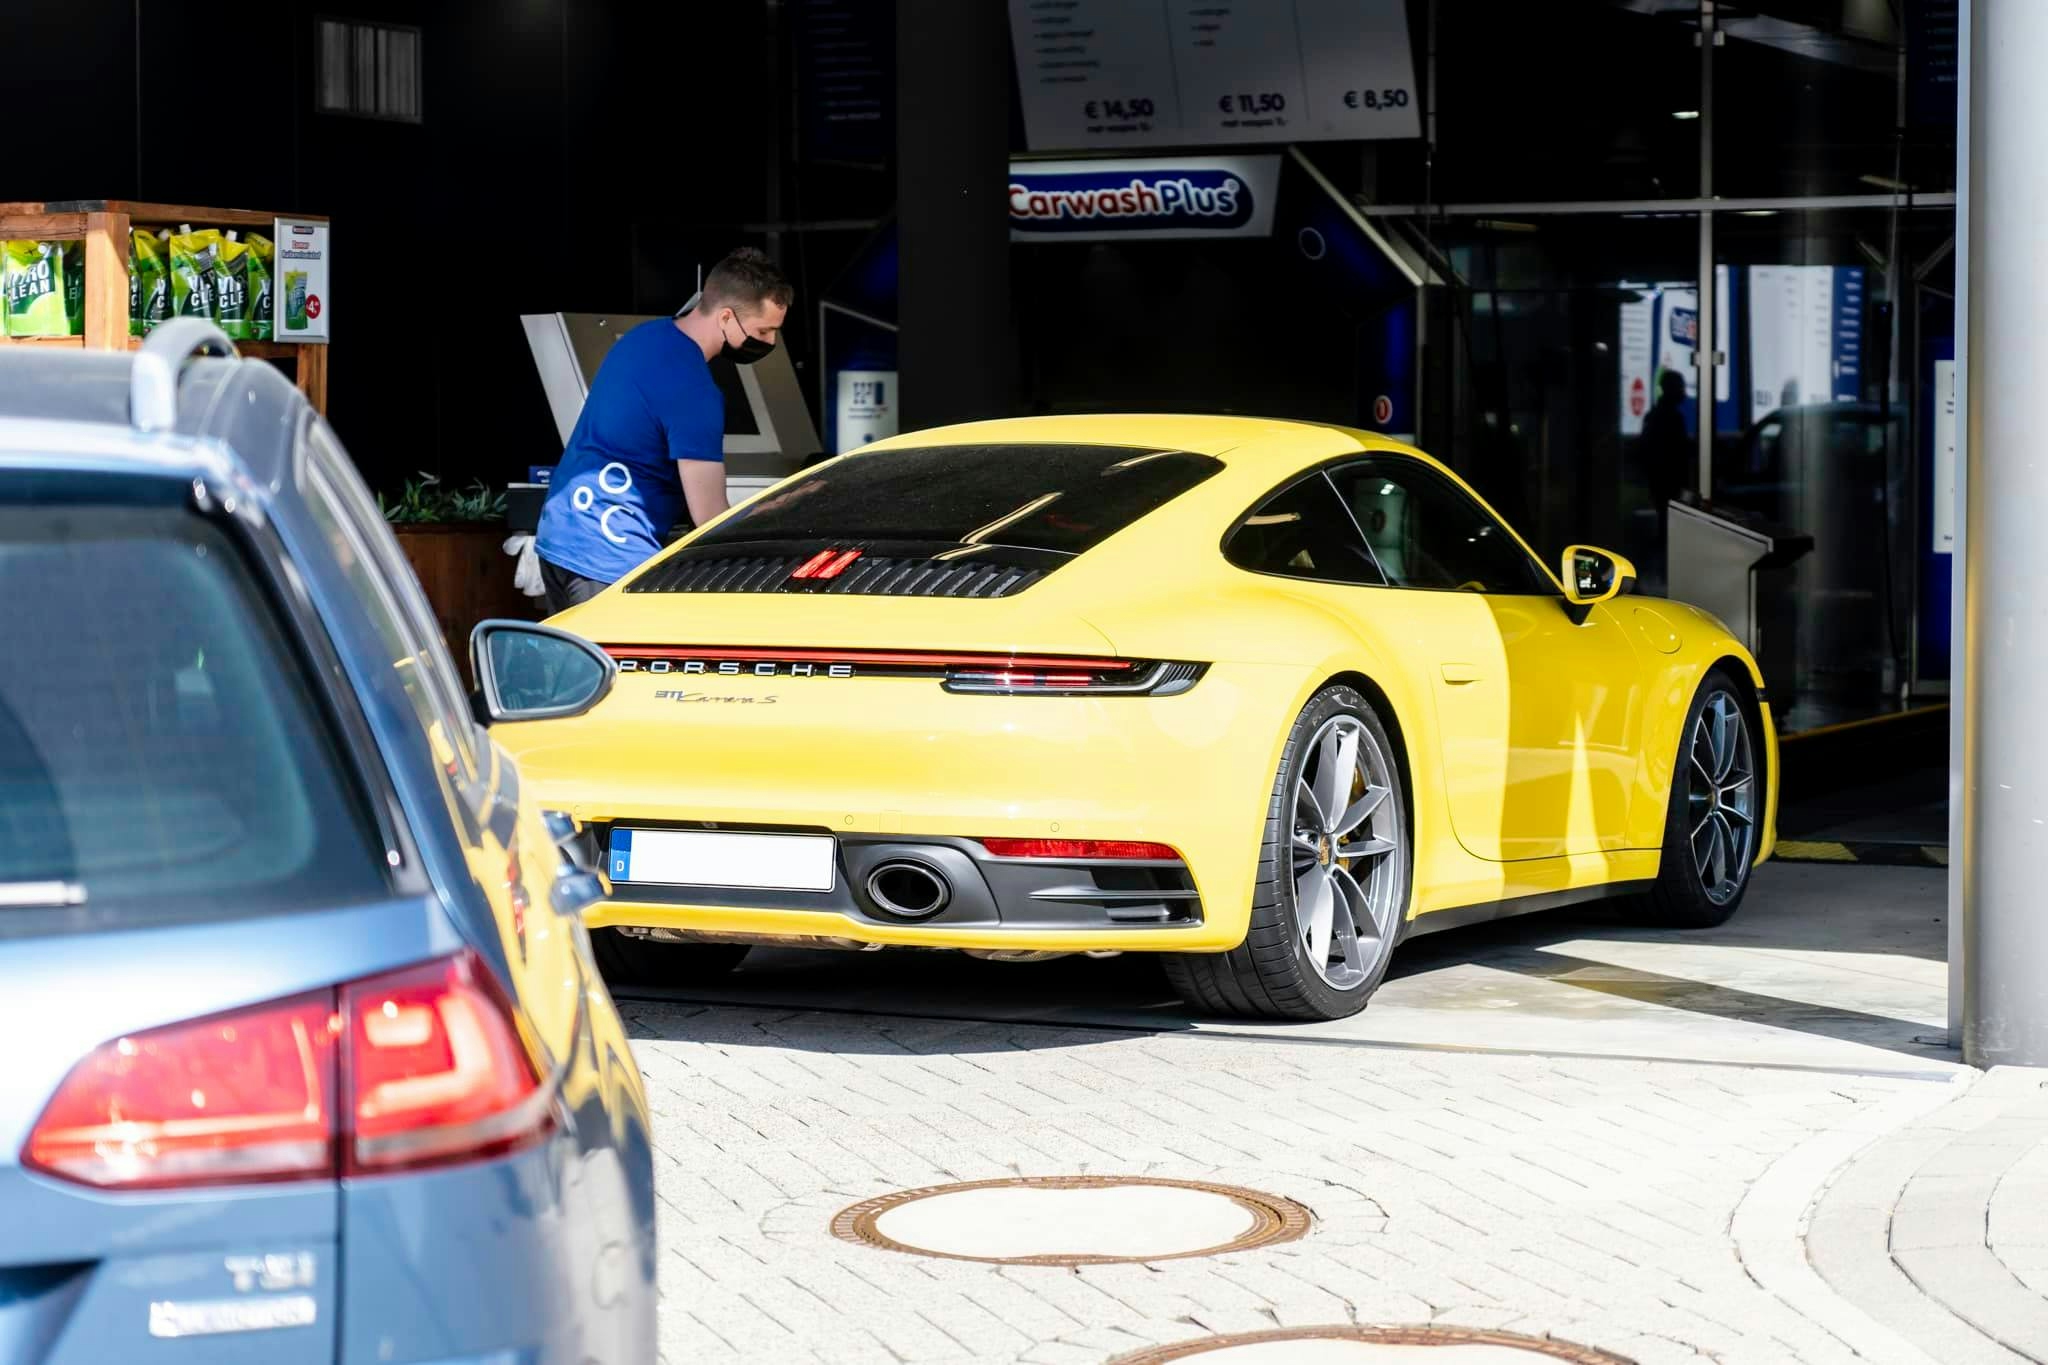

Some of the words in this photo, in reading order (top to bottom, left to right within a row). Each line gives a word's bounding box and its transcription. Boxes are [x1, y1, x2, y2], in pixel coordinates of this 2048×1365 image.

[1218, 94, 1233, 114] €
[1344, 90, 1359, 109] €
[1365, 88, 1409, 111] 8,50
[1085, 100, 1098, 119] €
[1103, 97, 1155, 122] 14,50
[618, 660, 853, 678] PORSCHE
[654, 689, 685, 701] 911
[678, 692, 755, 704] Carrera
[757, 695, 779, 704] S
[616, 860, 625, 872] D
